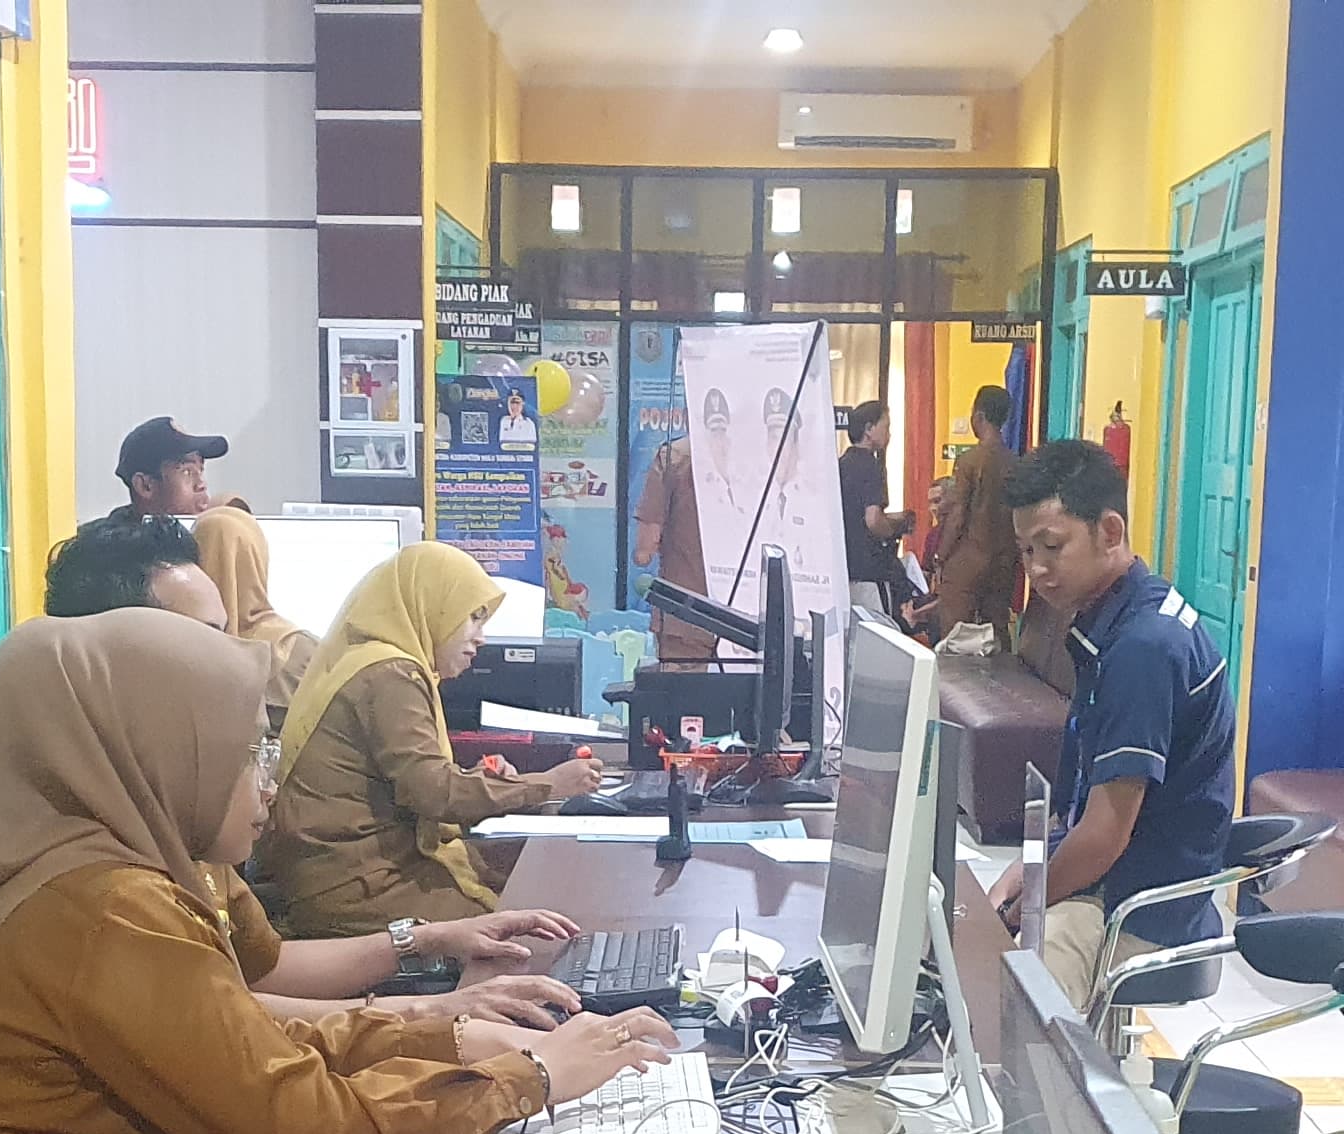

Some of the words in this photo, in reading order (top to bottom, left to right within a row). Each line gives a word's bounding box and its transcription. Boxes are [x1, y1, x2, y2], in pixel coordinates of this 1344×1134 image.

[1096, 268, 1175, 290] AULA
[435, 283, 478, 302] BIDANG
[480, 284, 509, 303] PIAK
[436, 312, 459, 325] UANG
[461, 312, 513, 326] PENGADUAN
[450, 326, 490, 339] LAYANAN
[639, 407, 687, 432] POJO
